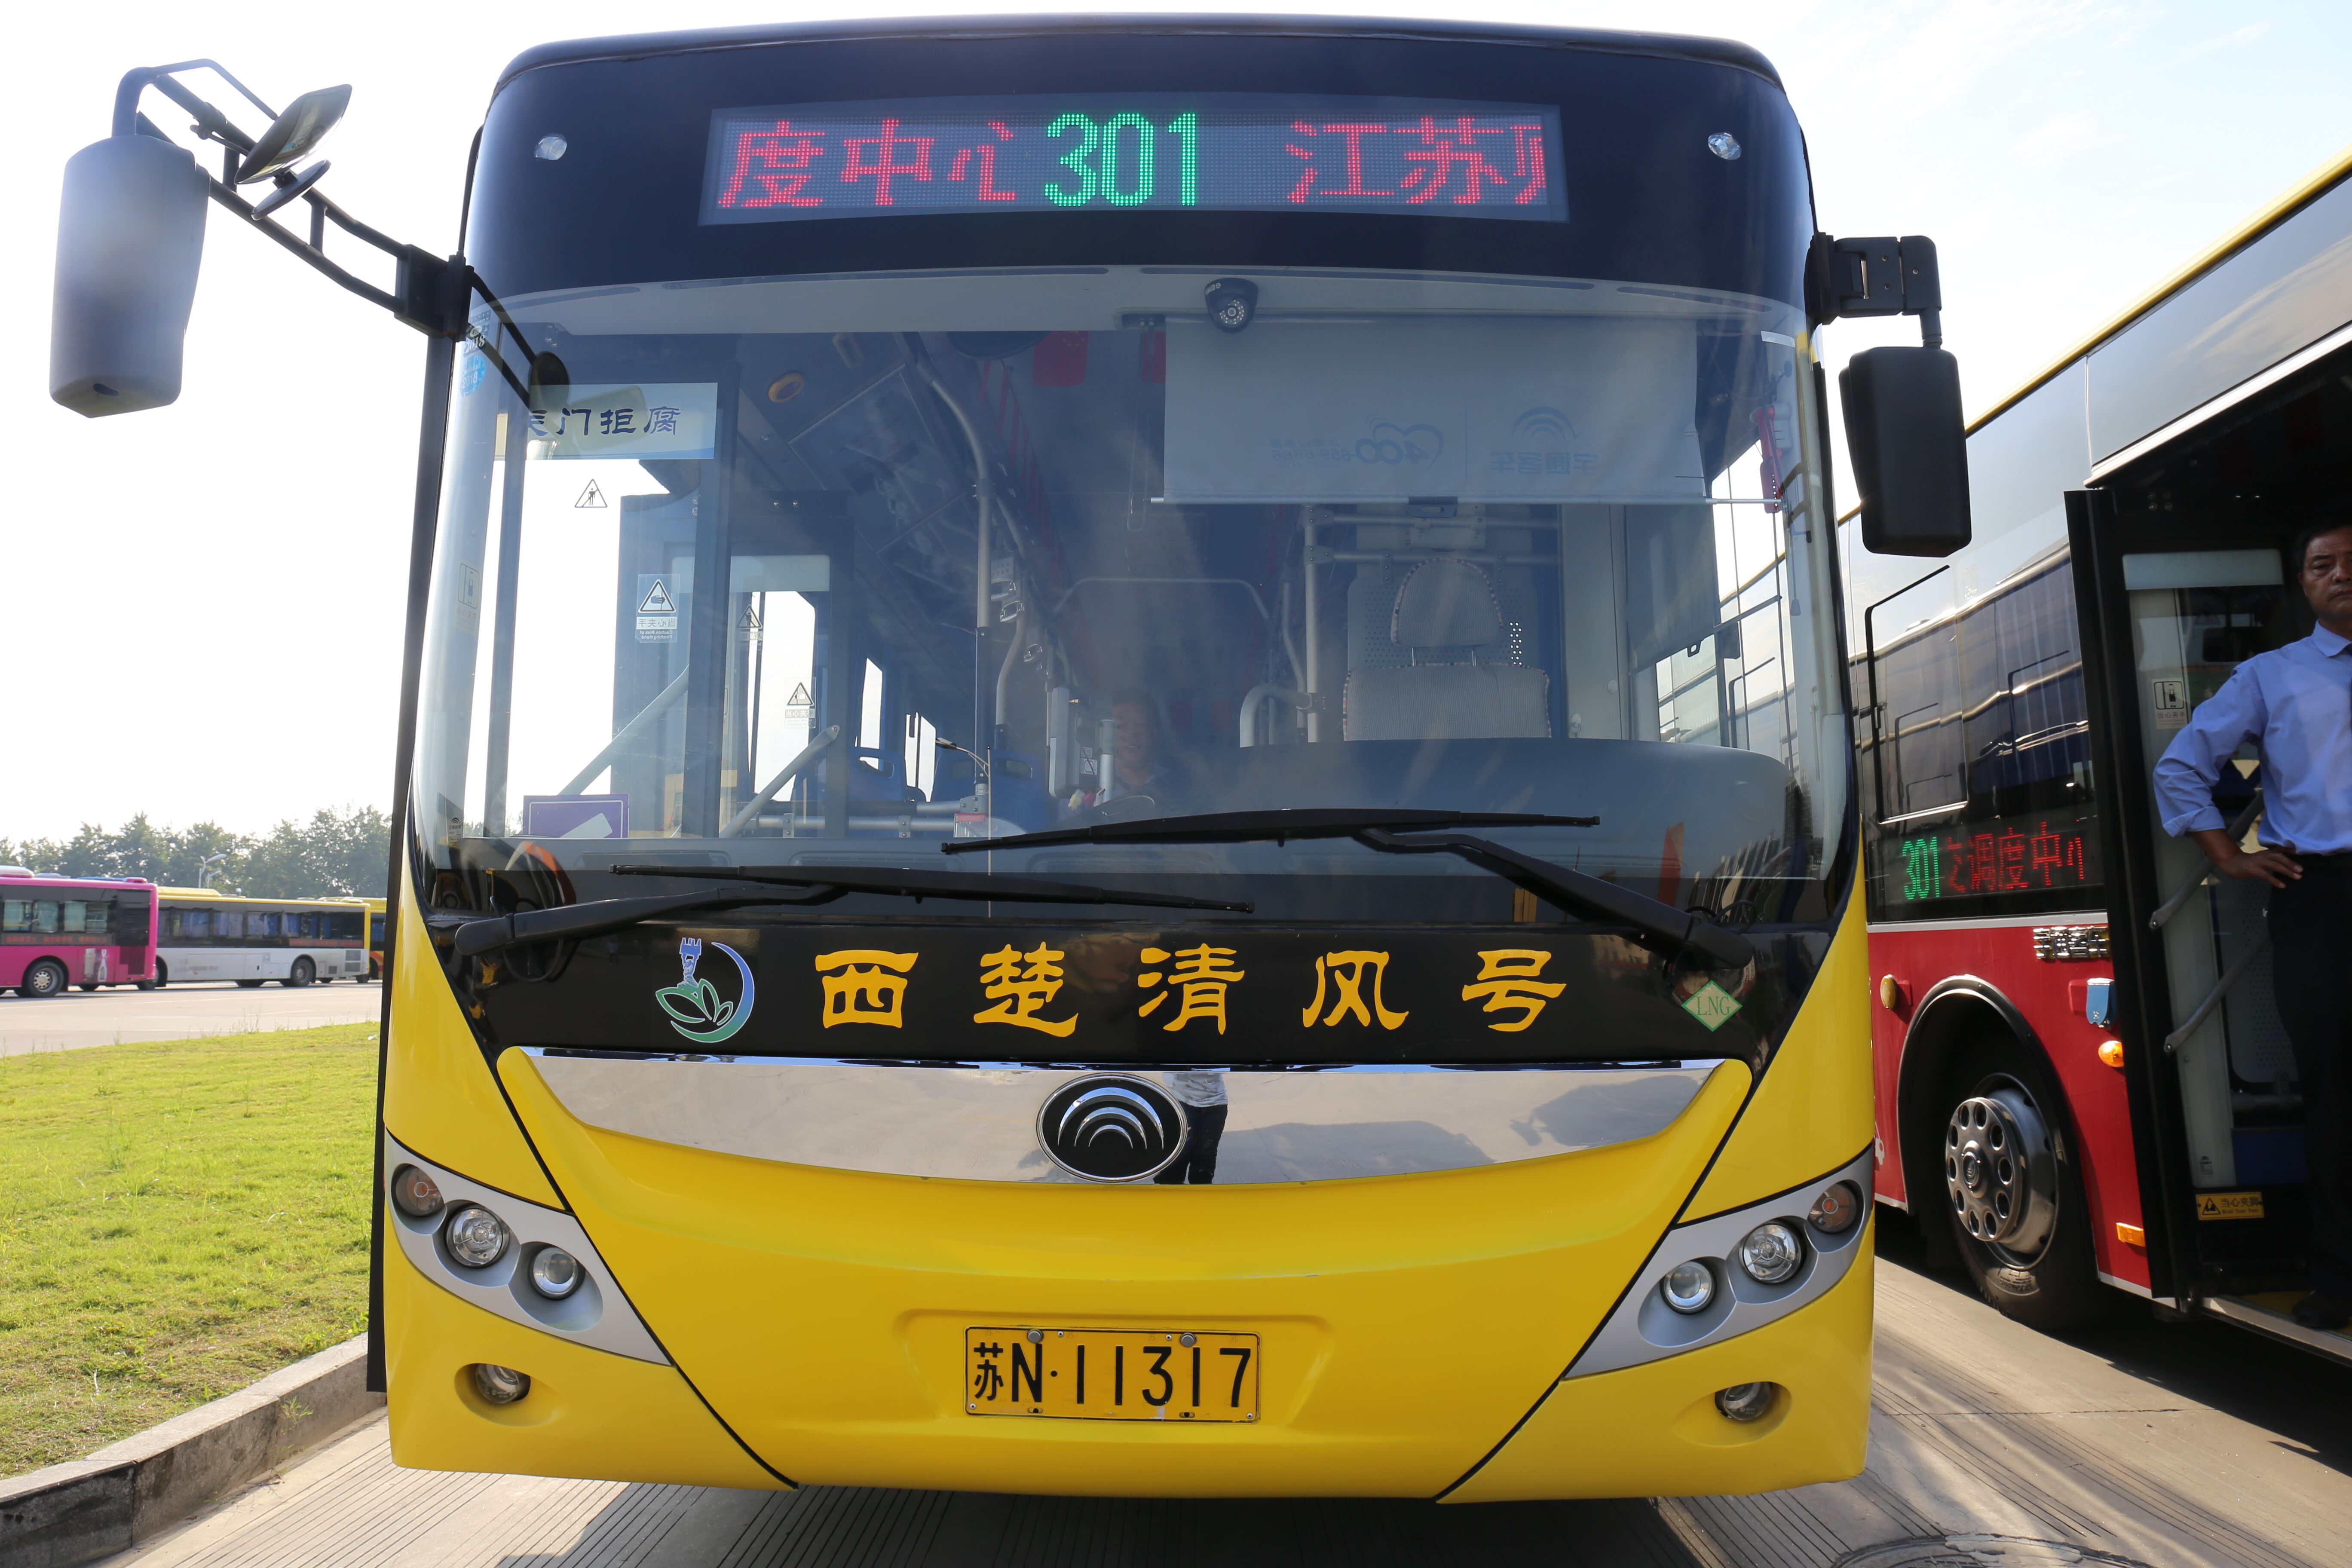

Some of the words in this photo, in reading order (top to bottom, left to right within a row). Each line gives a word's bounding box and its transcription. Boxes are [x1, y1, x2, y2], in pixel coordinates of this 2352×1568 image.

[1045, 112, 1197, 207] 301
[1902, 836, 1940, 900] 301
[814, 941, 1567, 1037] 西楚清风号
[1696, 996, 1731, 1016] LNG
